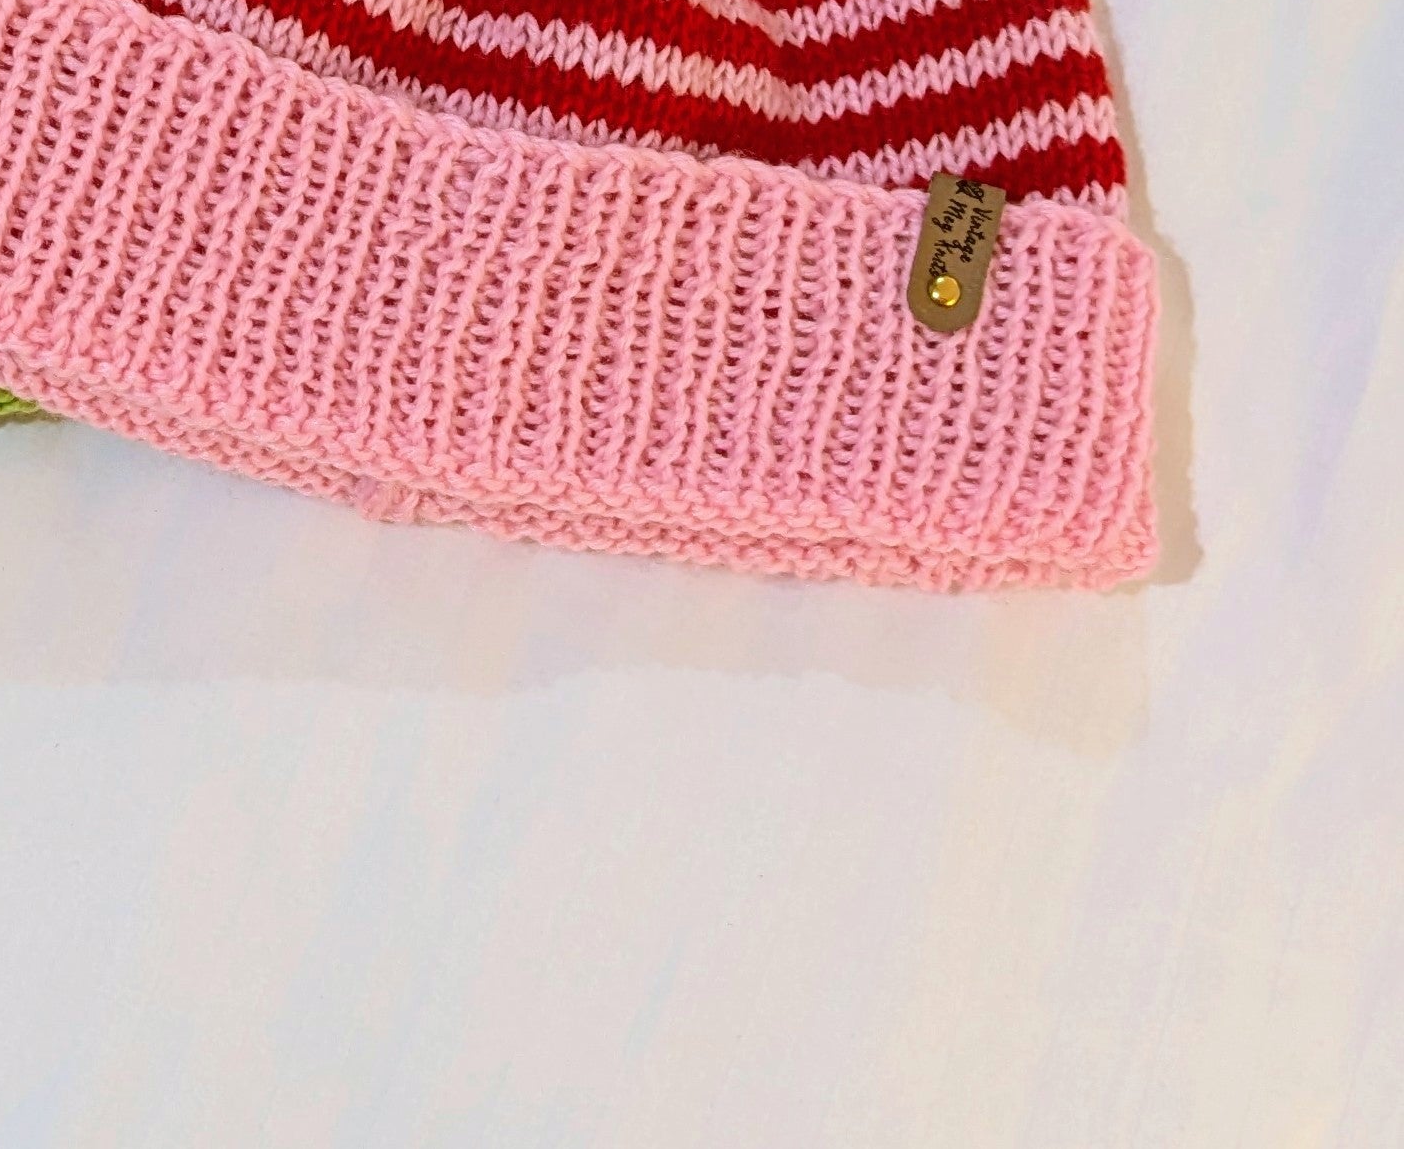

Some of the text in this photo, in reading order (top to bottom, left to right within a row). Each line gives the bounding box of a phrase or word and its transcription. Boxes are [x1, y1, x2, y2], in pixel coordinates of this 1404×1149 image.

[929, 199, 968, 277] Meg Knits
[953, 207, 993, 263] Vintage
